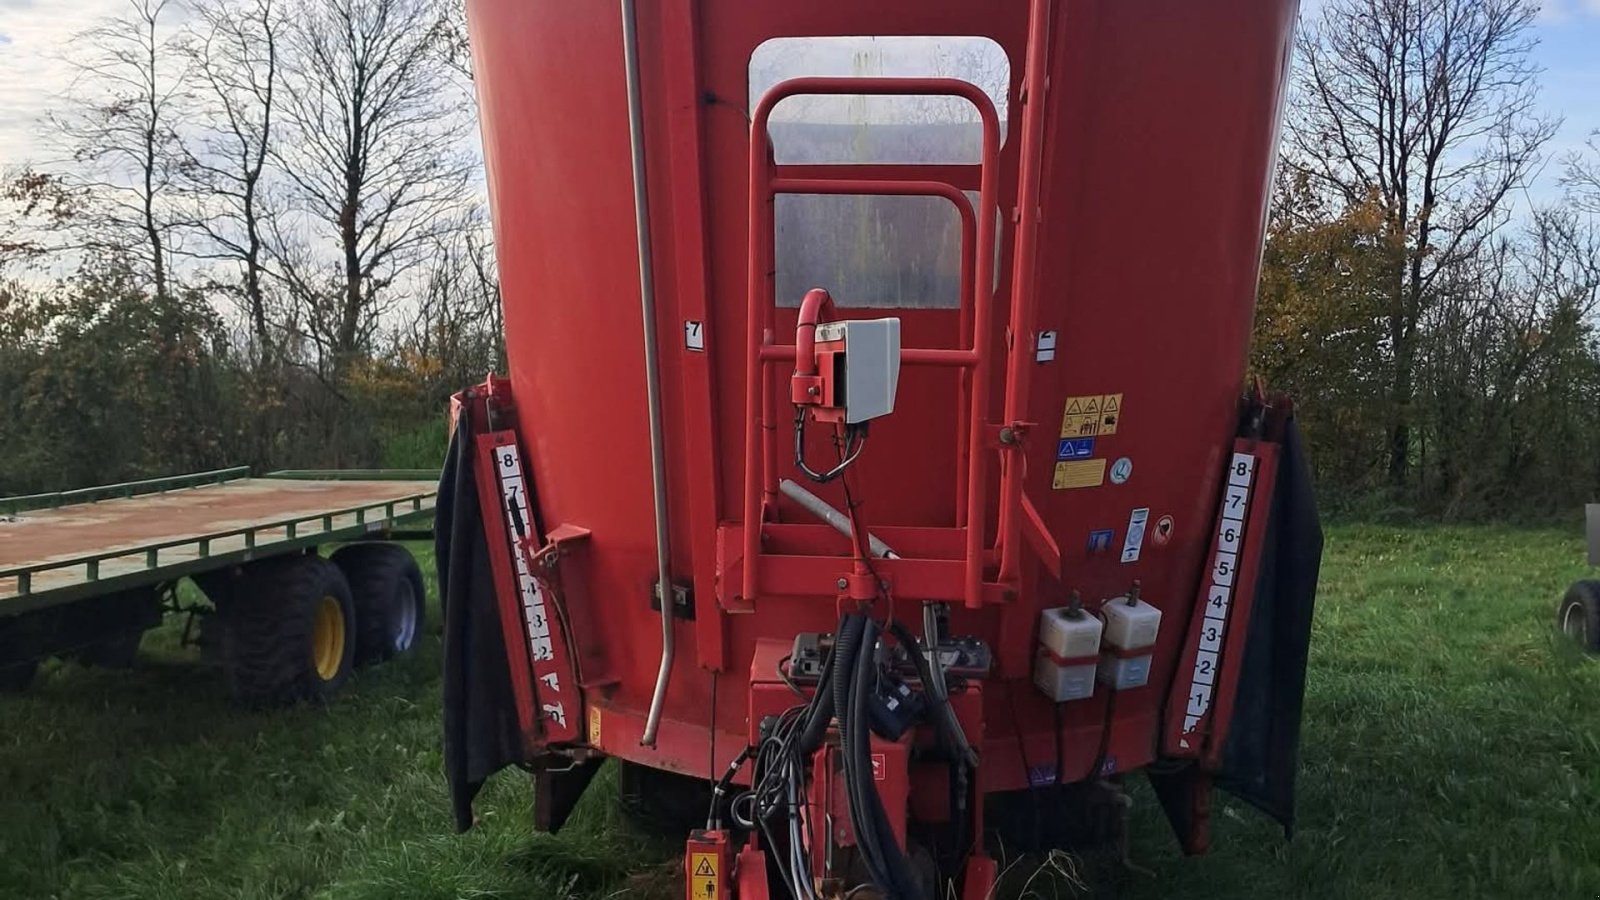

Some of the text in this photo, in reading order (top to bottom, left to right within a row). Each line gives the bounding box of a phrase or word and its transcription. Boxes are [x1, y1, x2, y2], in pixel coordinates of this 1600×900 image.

[690, 321, 700, 337] 7
[504, 454, 514, 468] 8
[1236, 462, 1247, 477] 8
[509, 486, 518, 500] 7
[1231, 495, 1242, 509] 7
[1224, 528, 1234, 542] 6
[1218, 561, 1229, 576] 5
[526, 581, 537, 596] 4
[1212, 594, 1223, 609] 4
[533, 614, 543, 629] 3
[1206, 627, 1217, 642] 3
[538, 646, 548, 660] 2
[1200, 660, 1211, 675] 2
[1195, 693, 1203, 708] 1
